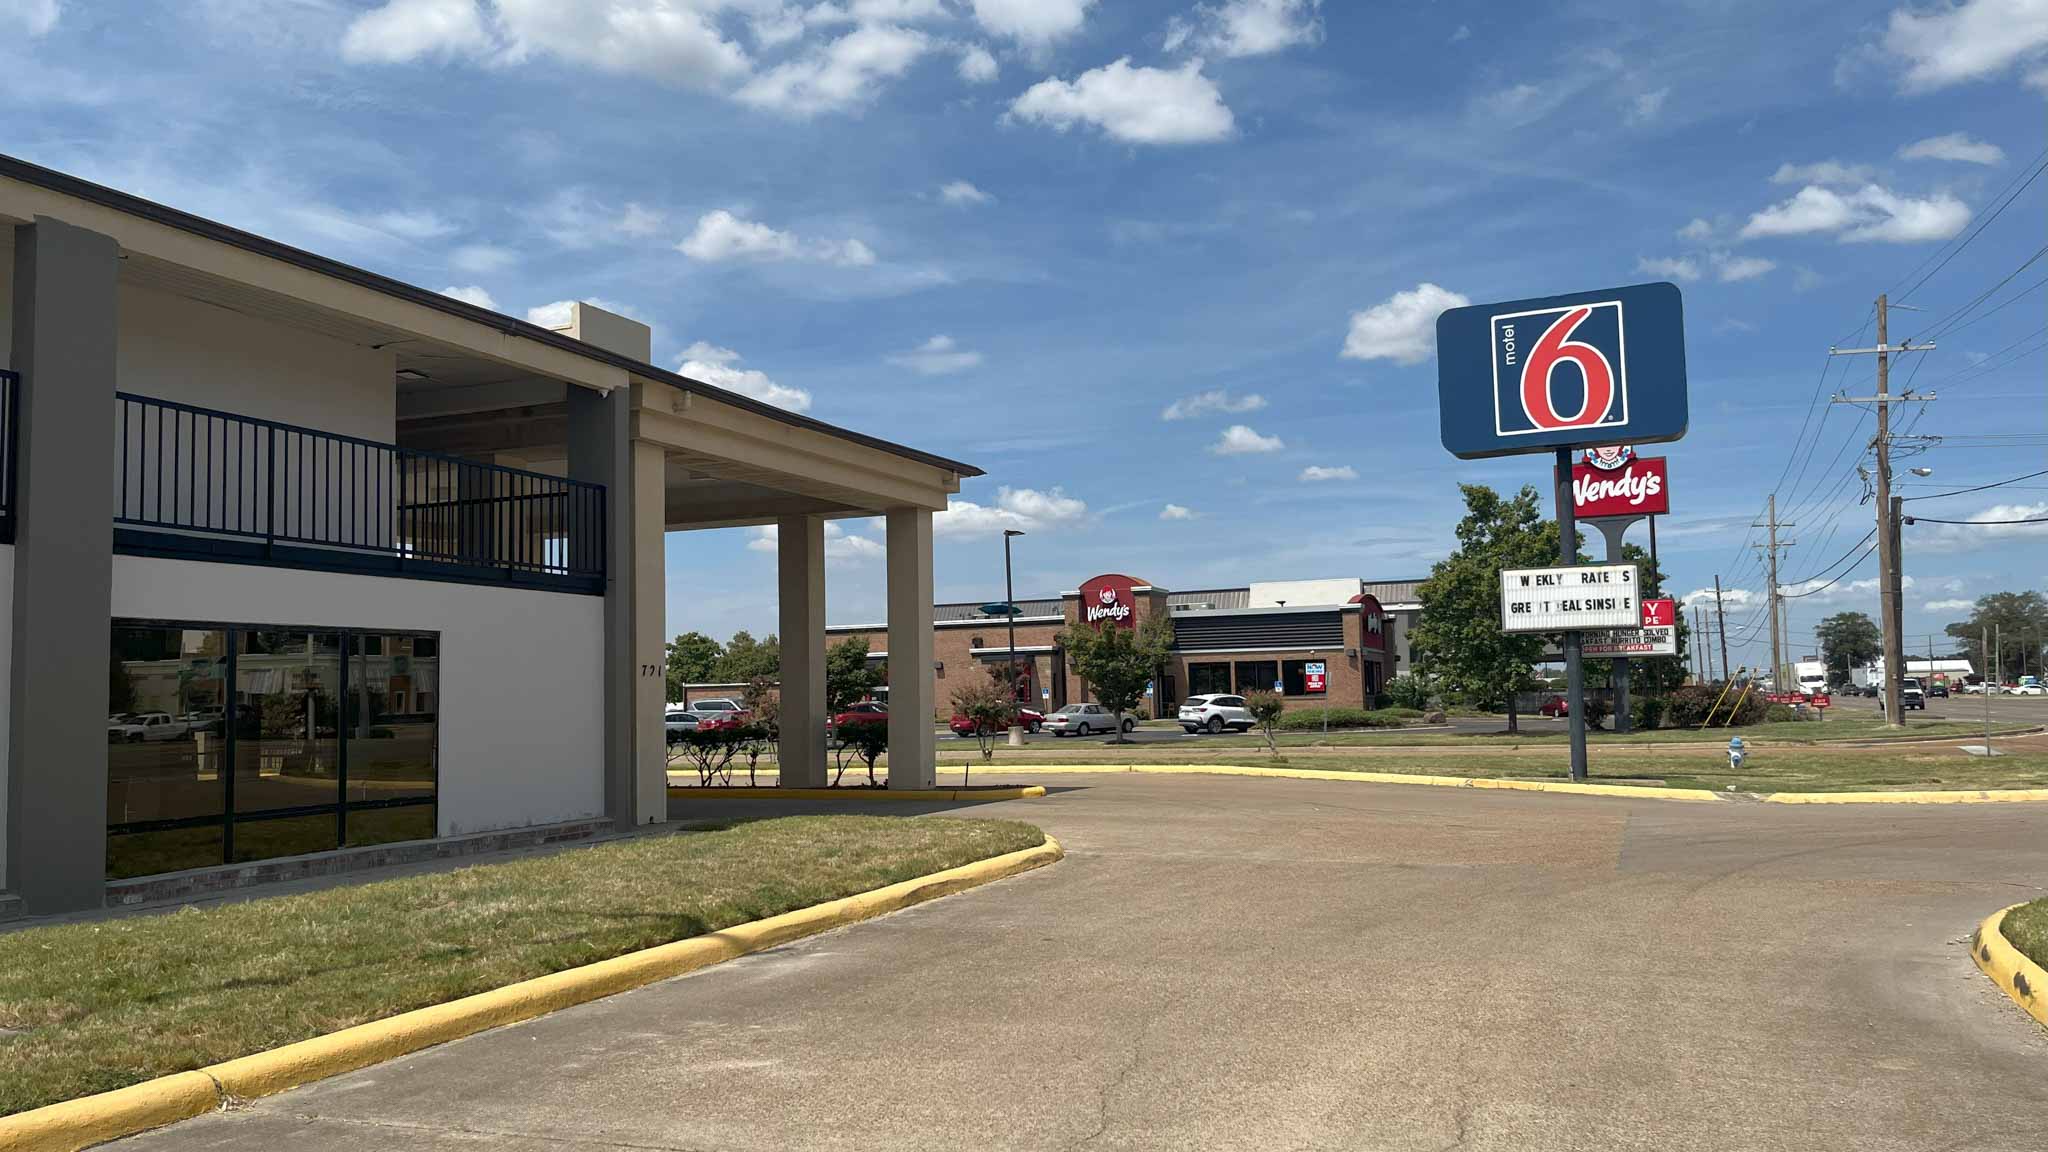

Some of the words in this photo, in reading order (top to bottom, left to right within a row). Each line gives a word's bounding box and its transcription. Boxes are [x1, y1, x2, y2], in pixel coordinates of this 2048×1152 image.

[1502, 324, 1516, 365] motel
[1520, 306, 1615, 429] 6
[1087, 601, 1130, 622] Wendy's
